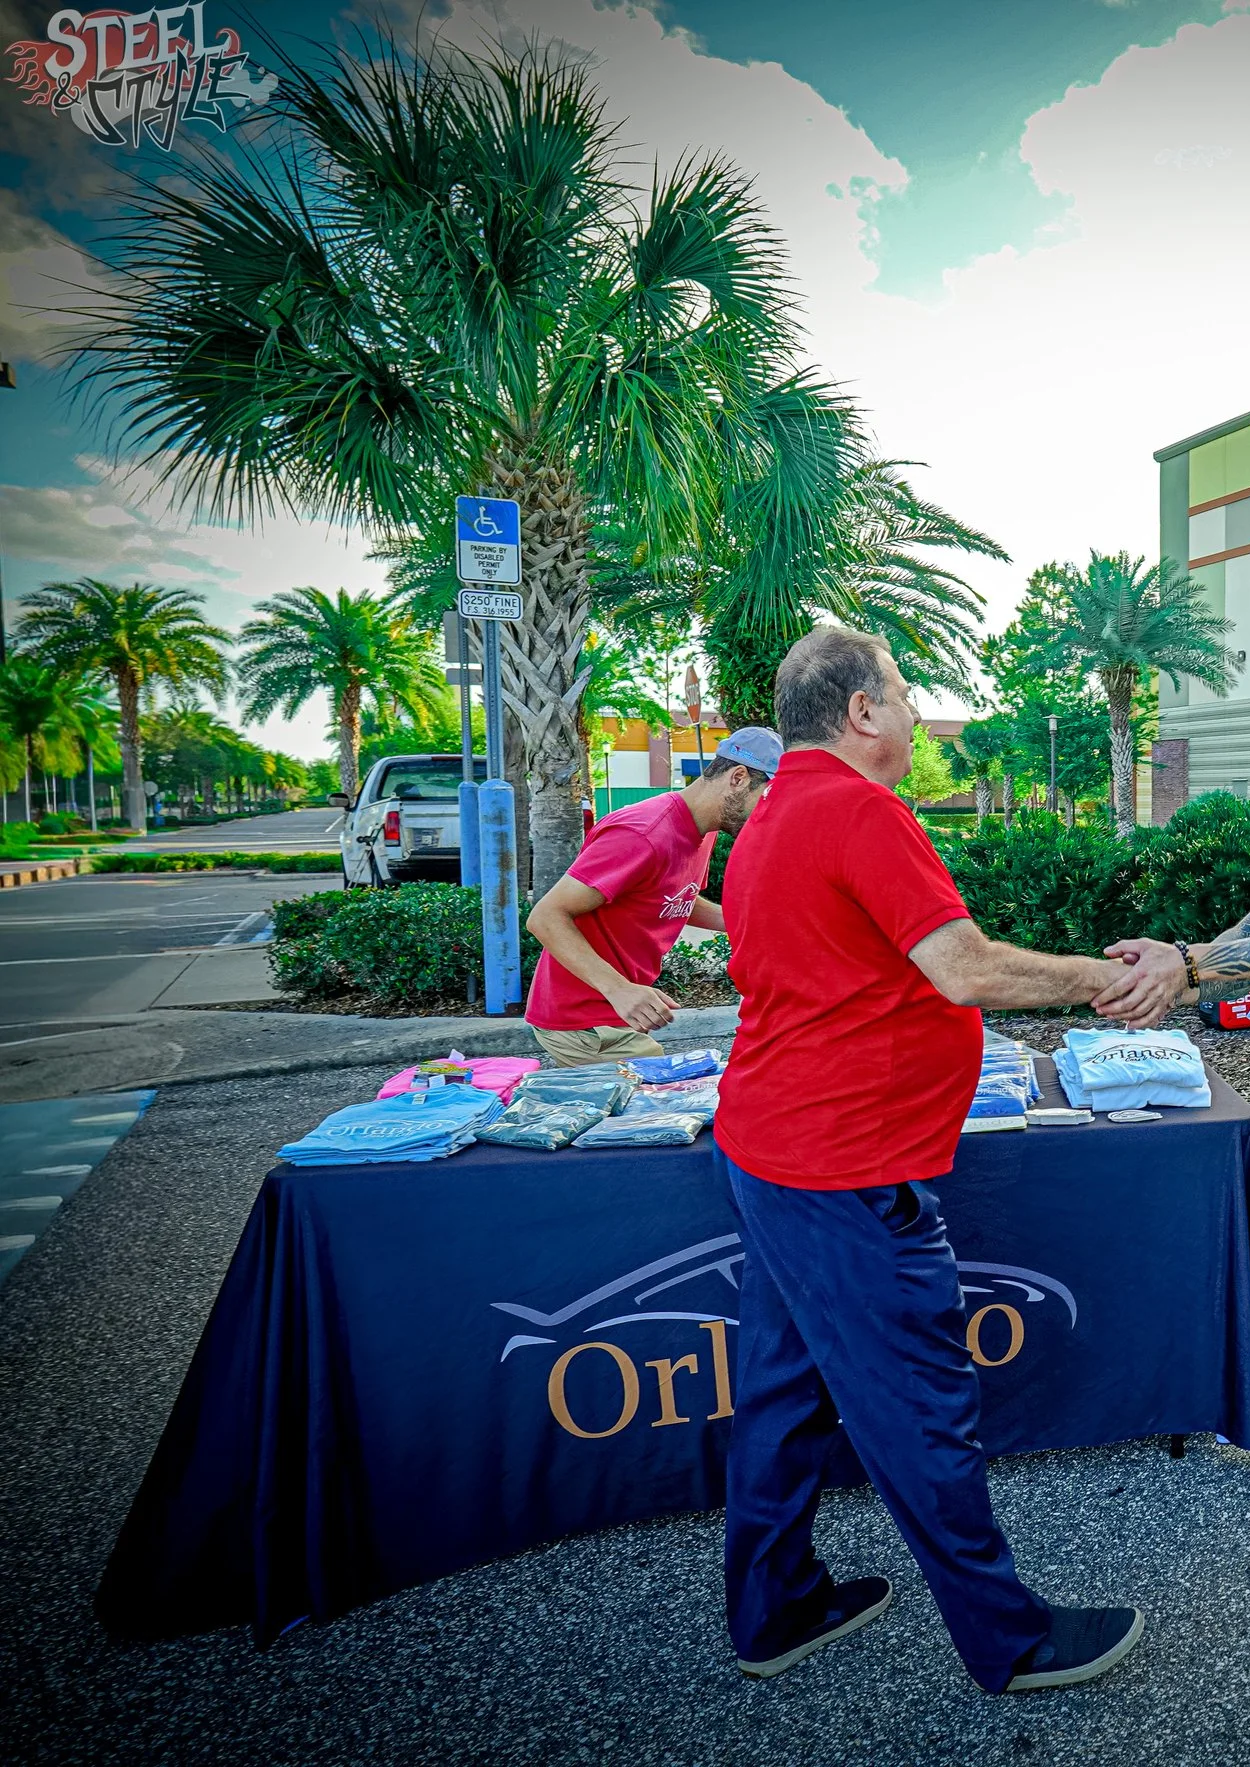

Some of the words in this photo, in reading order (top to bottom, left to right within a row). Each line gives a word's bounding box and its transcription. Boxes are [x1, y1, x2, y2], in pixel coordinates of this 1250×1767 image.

[470, 545, 497, 554] PARKING
[474, 552, 505, 561] DISABLED
[478, 560, 500, 569] PERMIT
[481, 568, 498, 576] ONLY
[463, 594, 491, 606] $250
[495, 597, 518, 608] FINE
[483, 607, 515, 616] 316.1955
[1092, 1048, 1181, 1065] Orlando
[326, 1121, 443, 1137] Orlando
[547, 1303, 1026, 1440] Orlo
